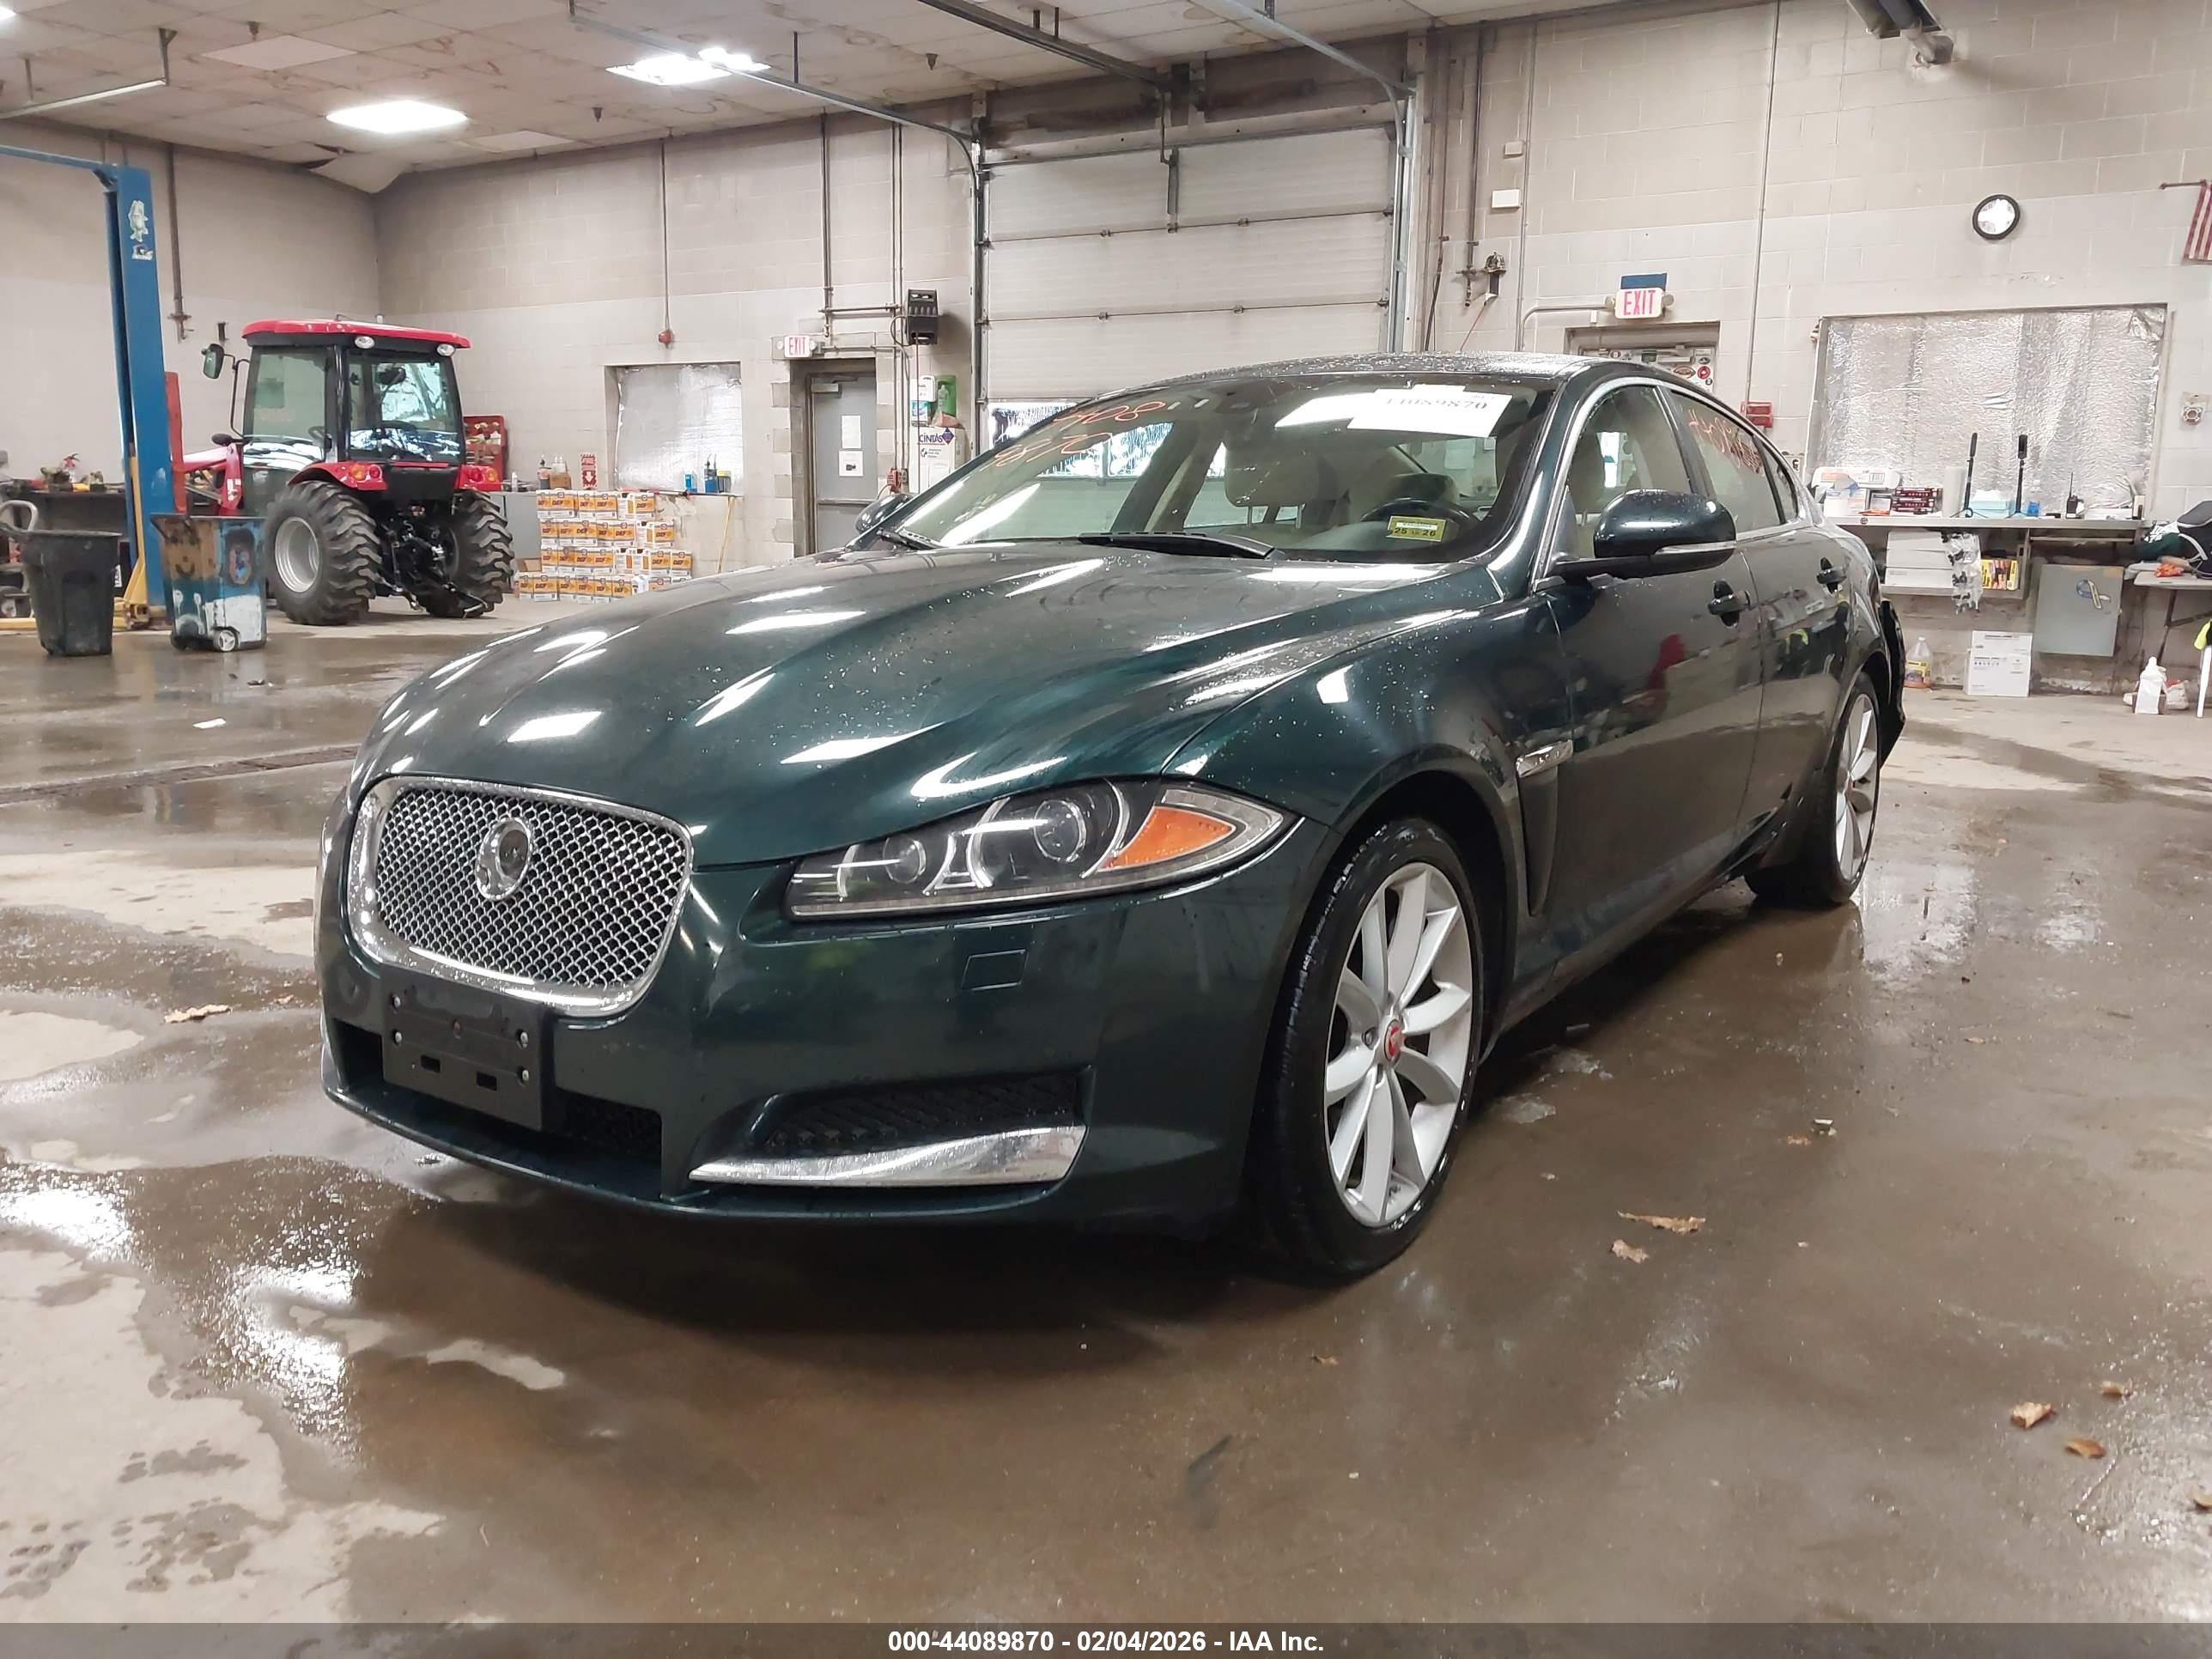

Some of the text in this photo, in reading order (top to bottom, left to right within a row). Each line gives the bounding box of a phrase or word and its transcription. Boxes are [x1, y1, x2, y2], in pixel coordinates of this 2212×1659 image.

[1623, 290, 1656, 316] EXIT
[788, 336, 805, 356] EXIT
[919, 433, 943, 443] CINTAS
